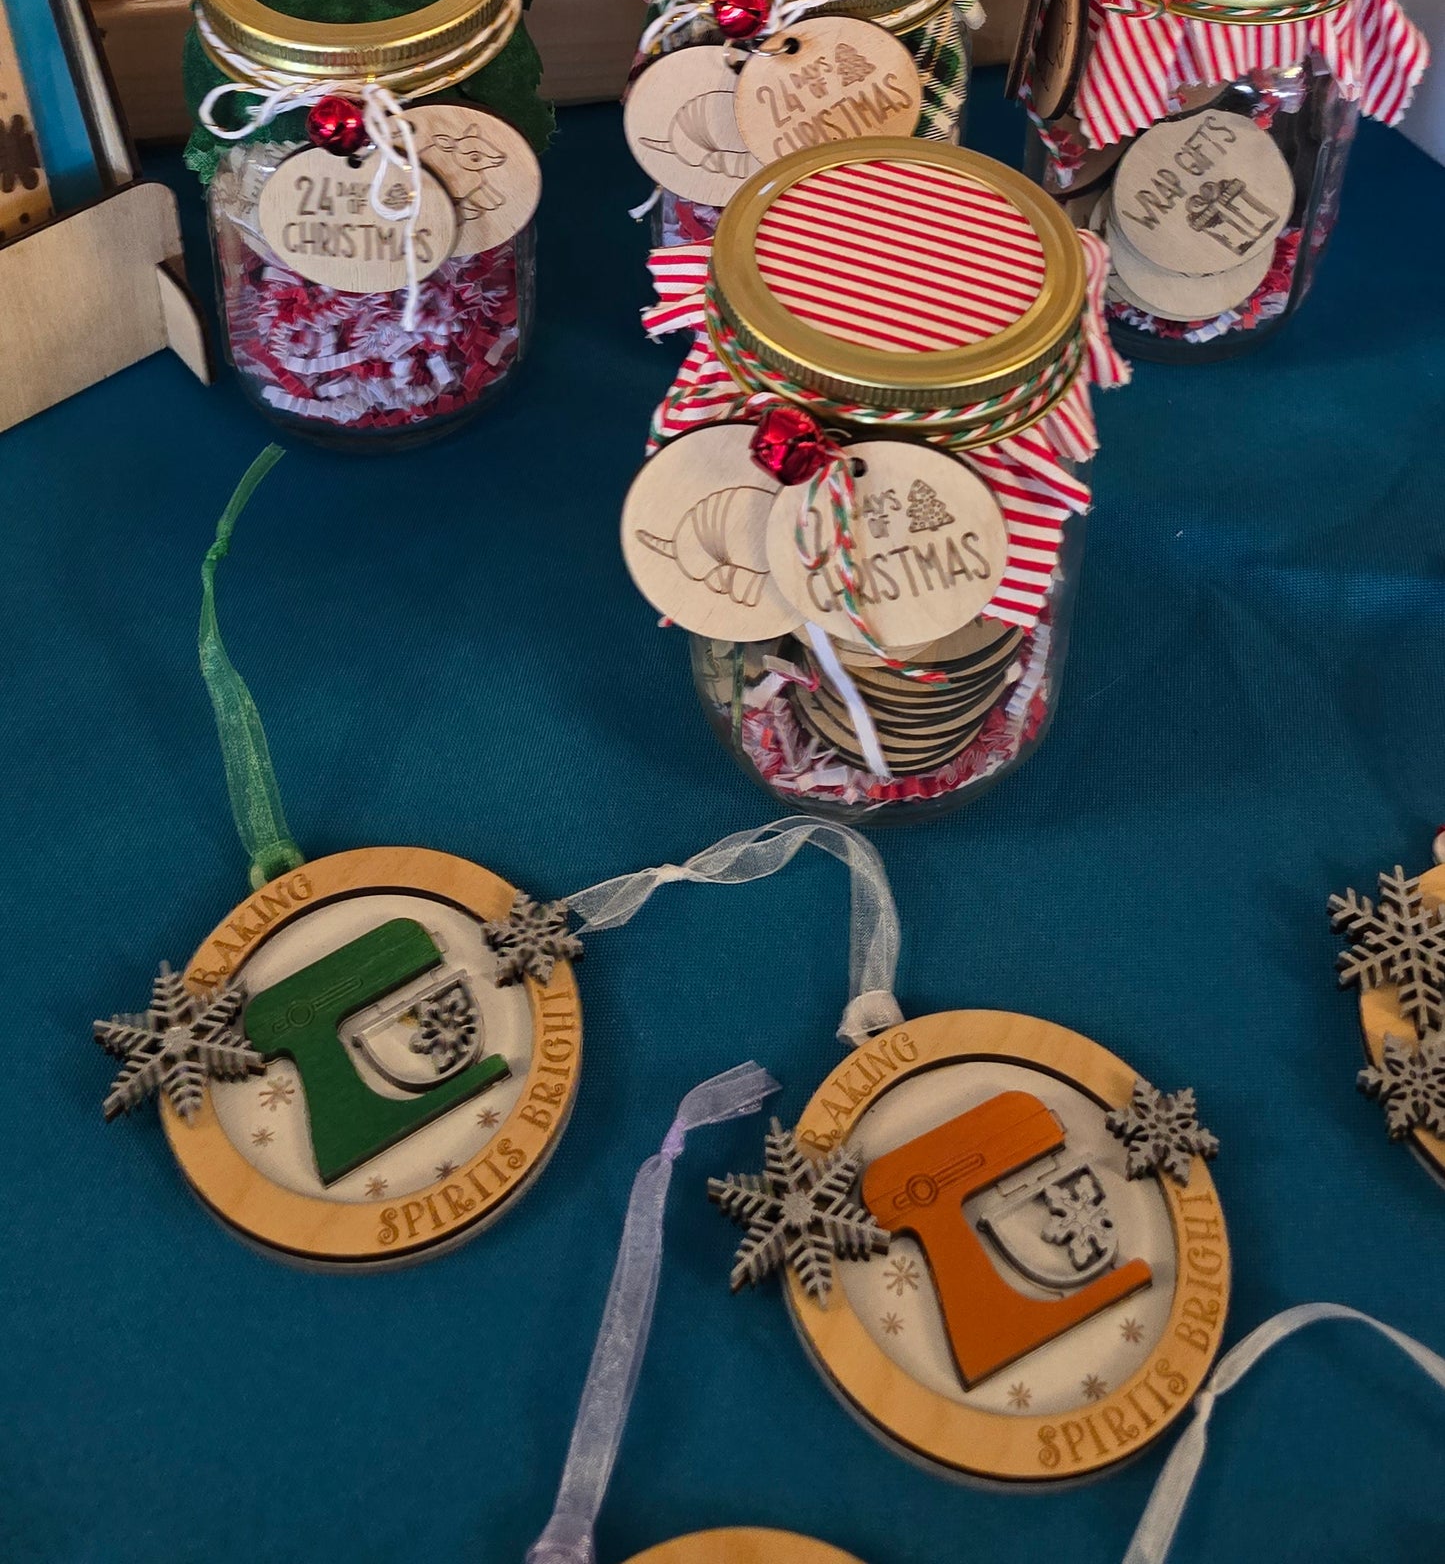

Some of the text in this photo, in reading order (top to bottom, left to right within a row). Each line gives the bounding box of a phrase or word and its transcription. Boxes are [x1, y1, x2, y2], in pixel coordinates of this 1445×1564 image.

[756, 56, 834, 129] 24 DAYS
[772, 72, 914, 158] CHRISTMAS
[294, 175, 372, 216] 24 DAY
[347, 198, 369, 214] OF
[1121, 115, 1237, 231] WRAP GIFTS
[856, 488, 903, 520] AYS
[187, 872, 316, 991] BAKING
[376, 987, 577, 1247] SPIRITS BRIGHT
[799, 1030, 919, 1155] BAKING
[1034, 1186, 1225, 1470] SPIRITS BRIGHT
